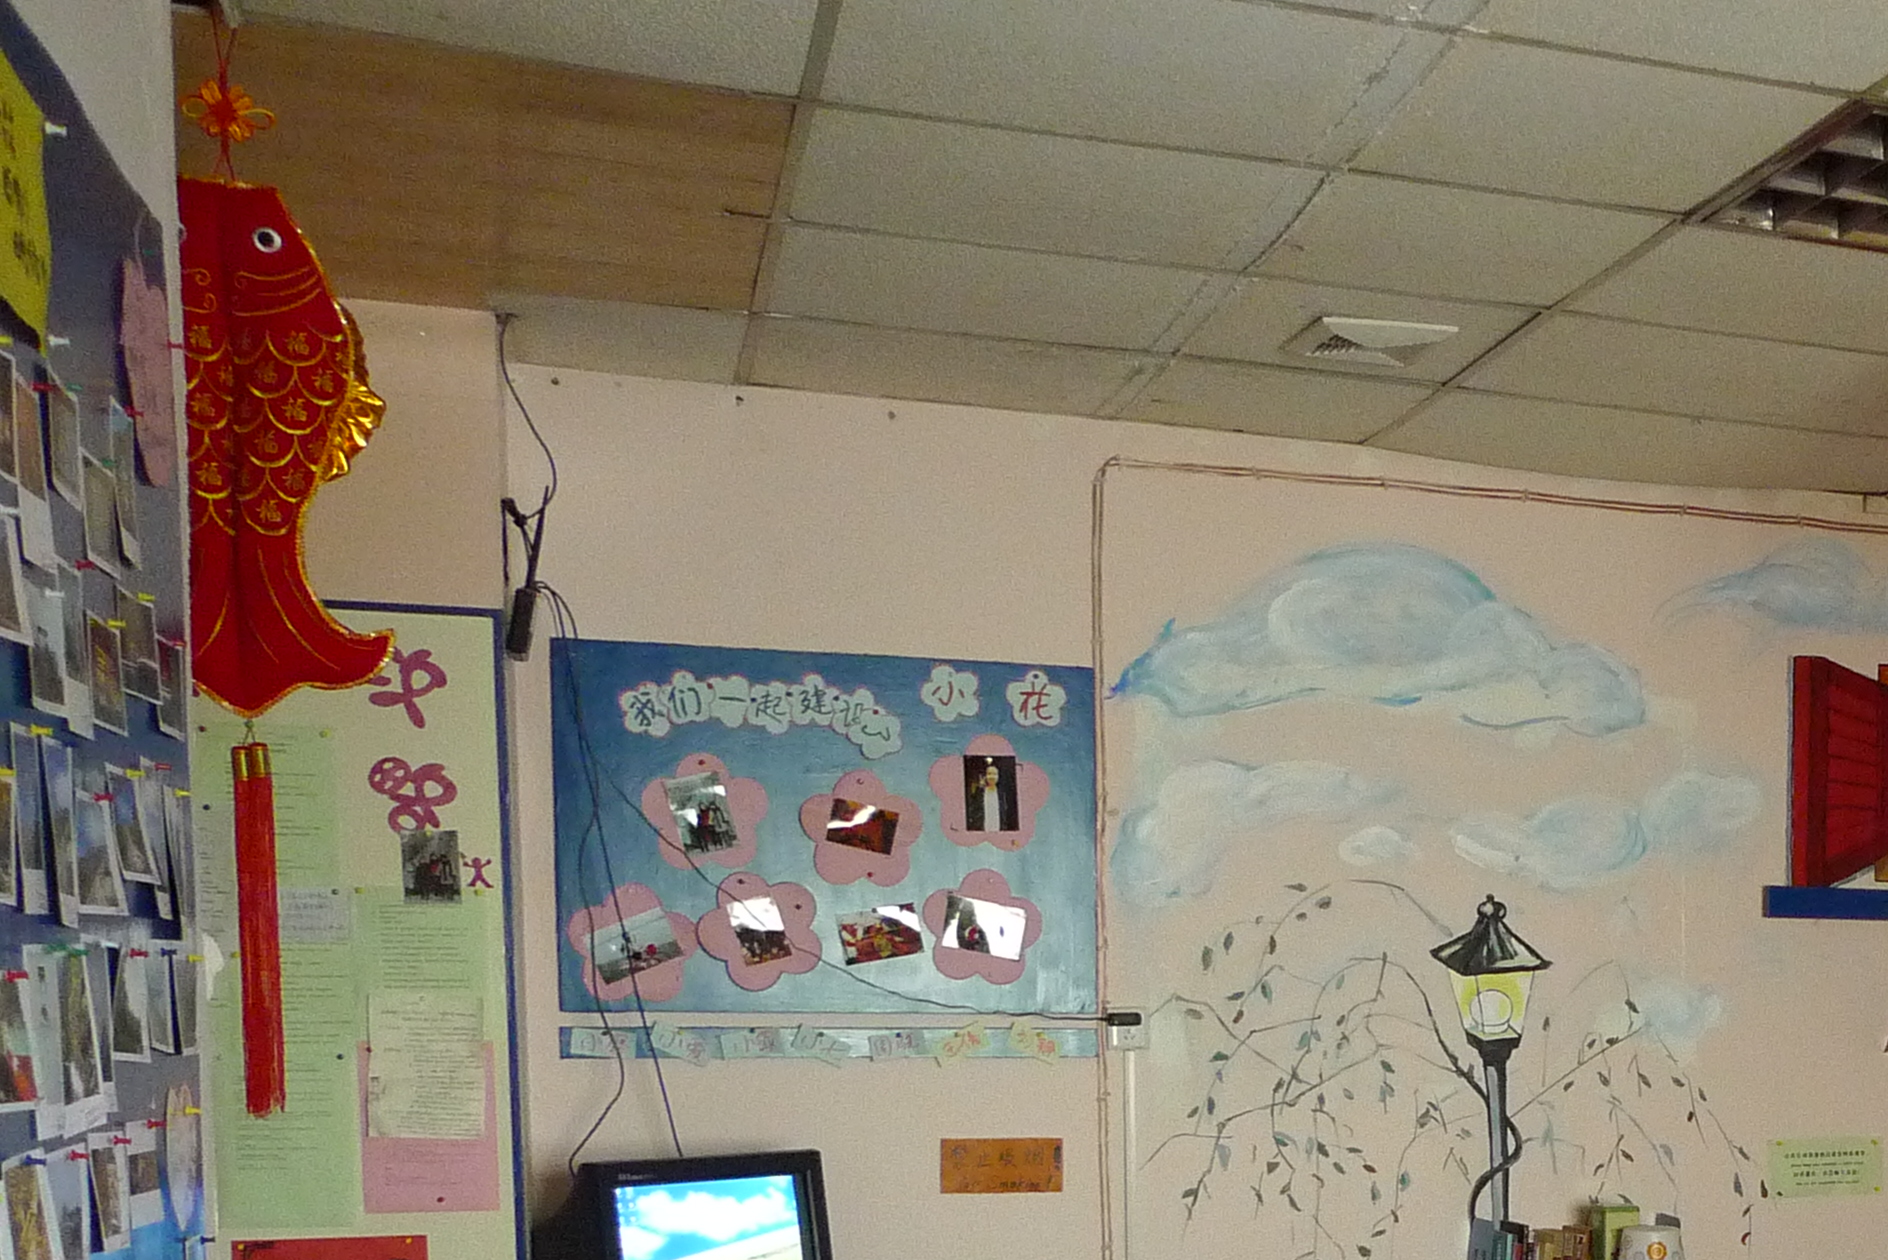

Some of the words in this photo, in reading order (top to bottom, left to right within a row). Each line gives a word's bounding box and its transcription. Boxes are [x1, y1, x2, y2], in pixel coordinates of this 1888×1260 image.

[283, 330, 310, 355] 福
[311, 367, 335, 392] 福
[190, 392, 216, 417] 福
[281, 397, 308, 422] 福
[253, 430, 279, 454] 福
[195, 461, 222, 486] 福
[255, 499, 282, 523] 福
